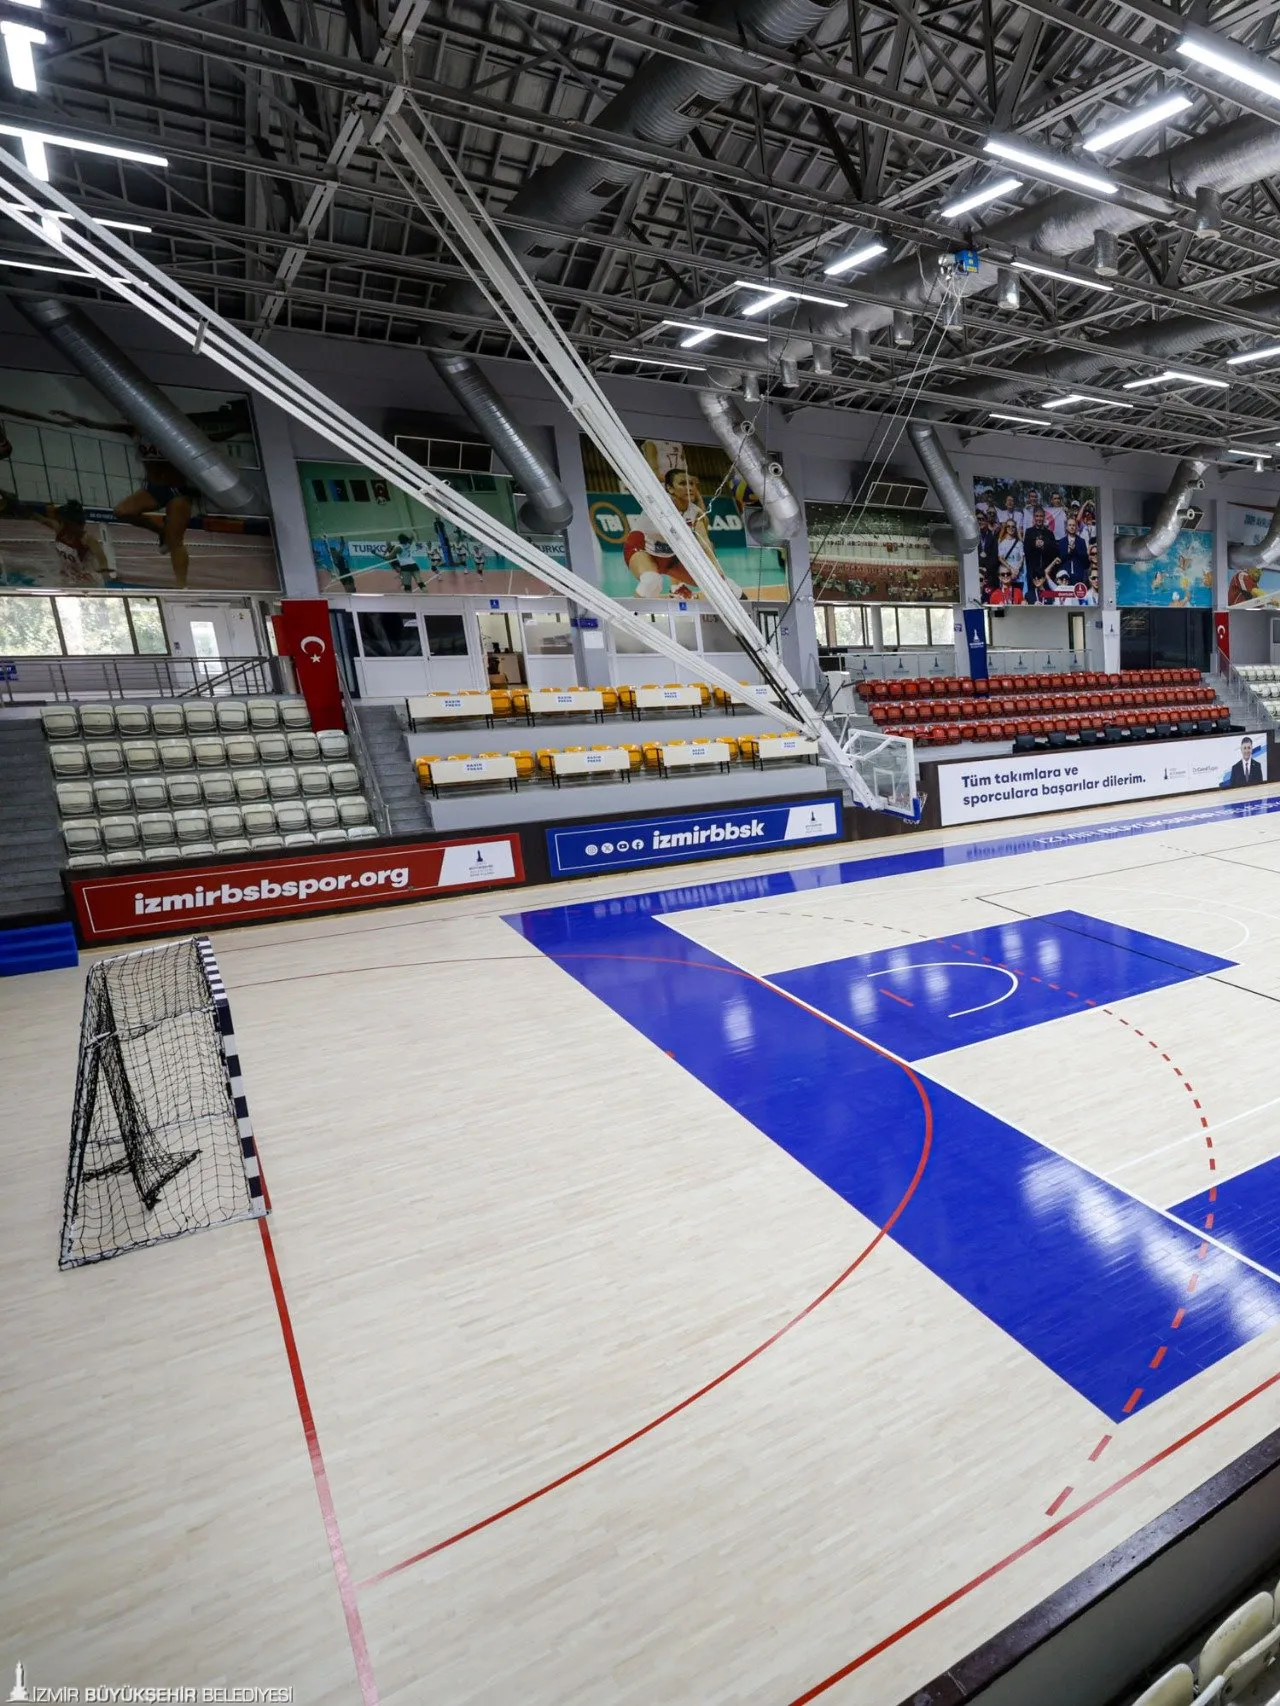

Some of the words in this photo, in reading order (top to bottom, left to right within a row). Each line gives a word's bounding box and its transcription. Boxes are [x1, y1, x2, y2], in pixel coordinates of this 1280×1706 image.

[961, 774, 991, 788] Tüm
[994, 768, 1061, 784] takımlara
[1064, 767, 1079, 776] ve
[963, 787, 1039, 807] sporculara
[1042, 779, 1100, 795] başarılar
[1102, 773, 1146, 788] dilerim.
[652, 819, 765, 850] izmirbbsk
[134, 867, 409, 915] izmirbsbspor.org
